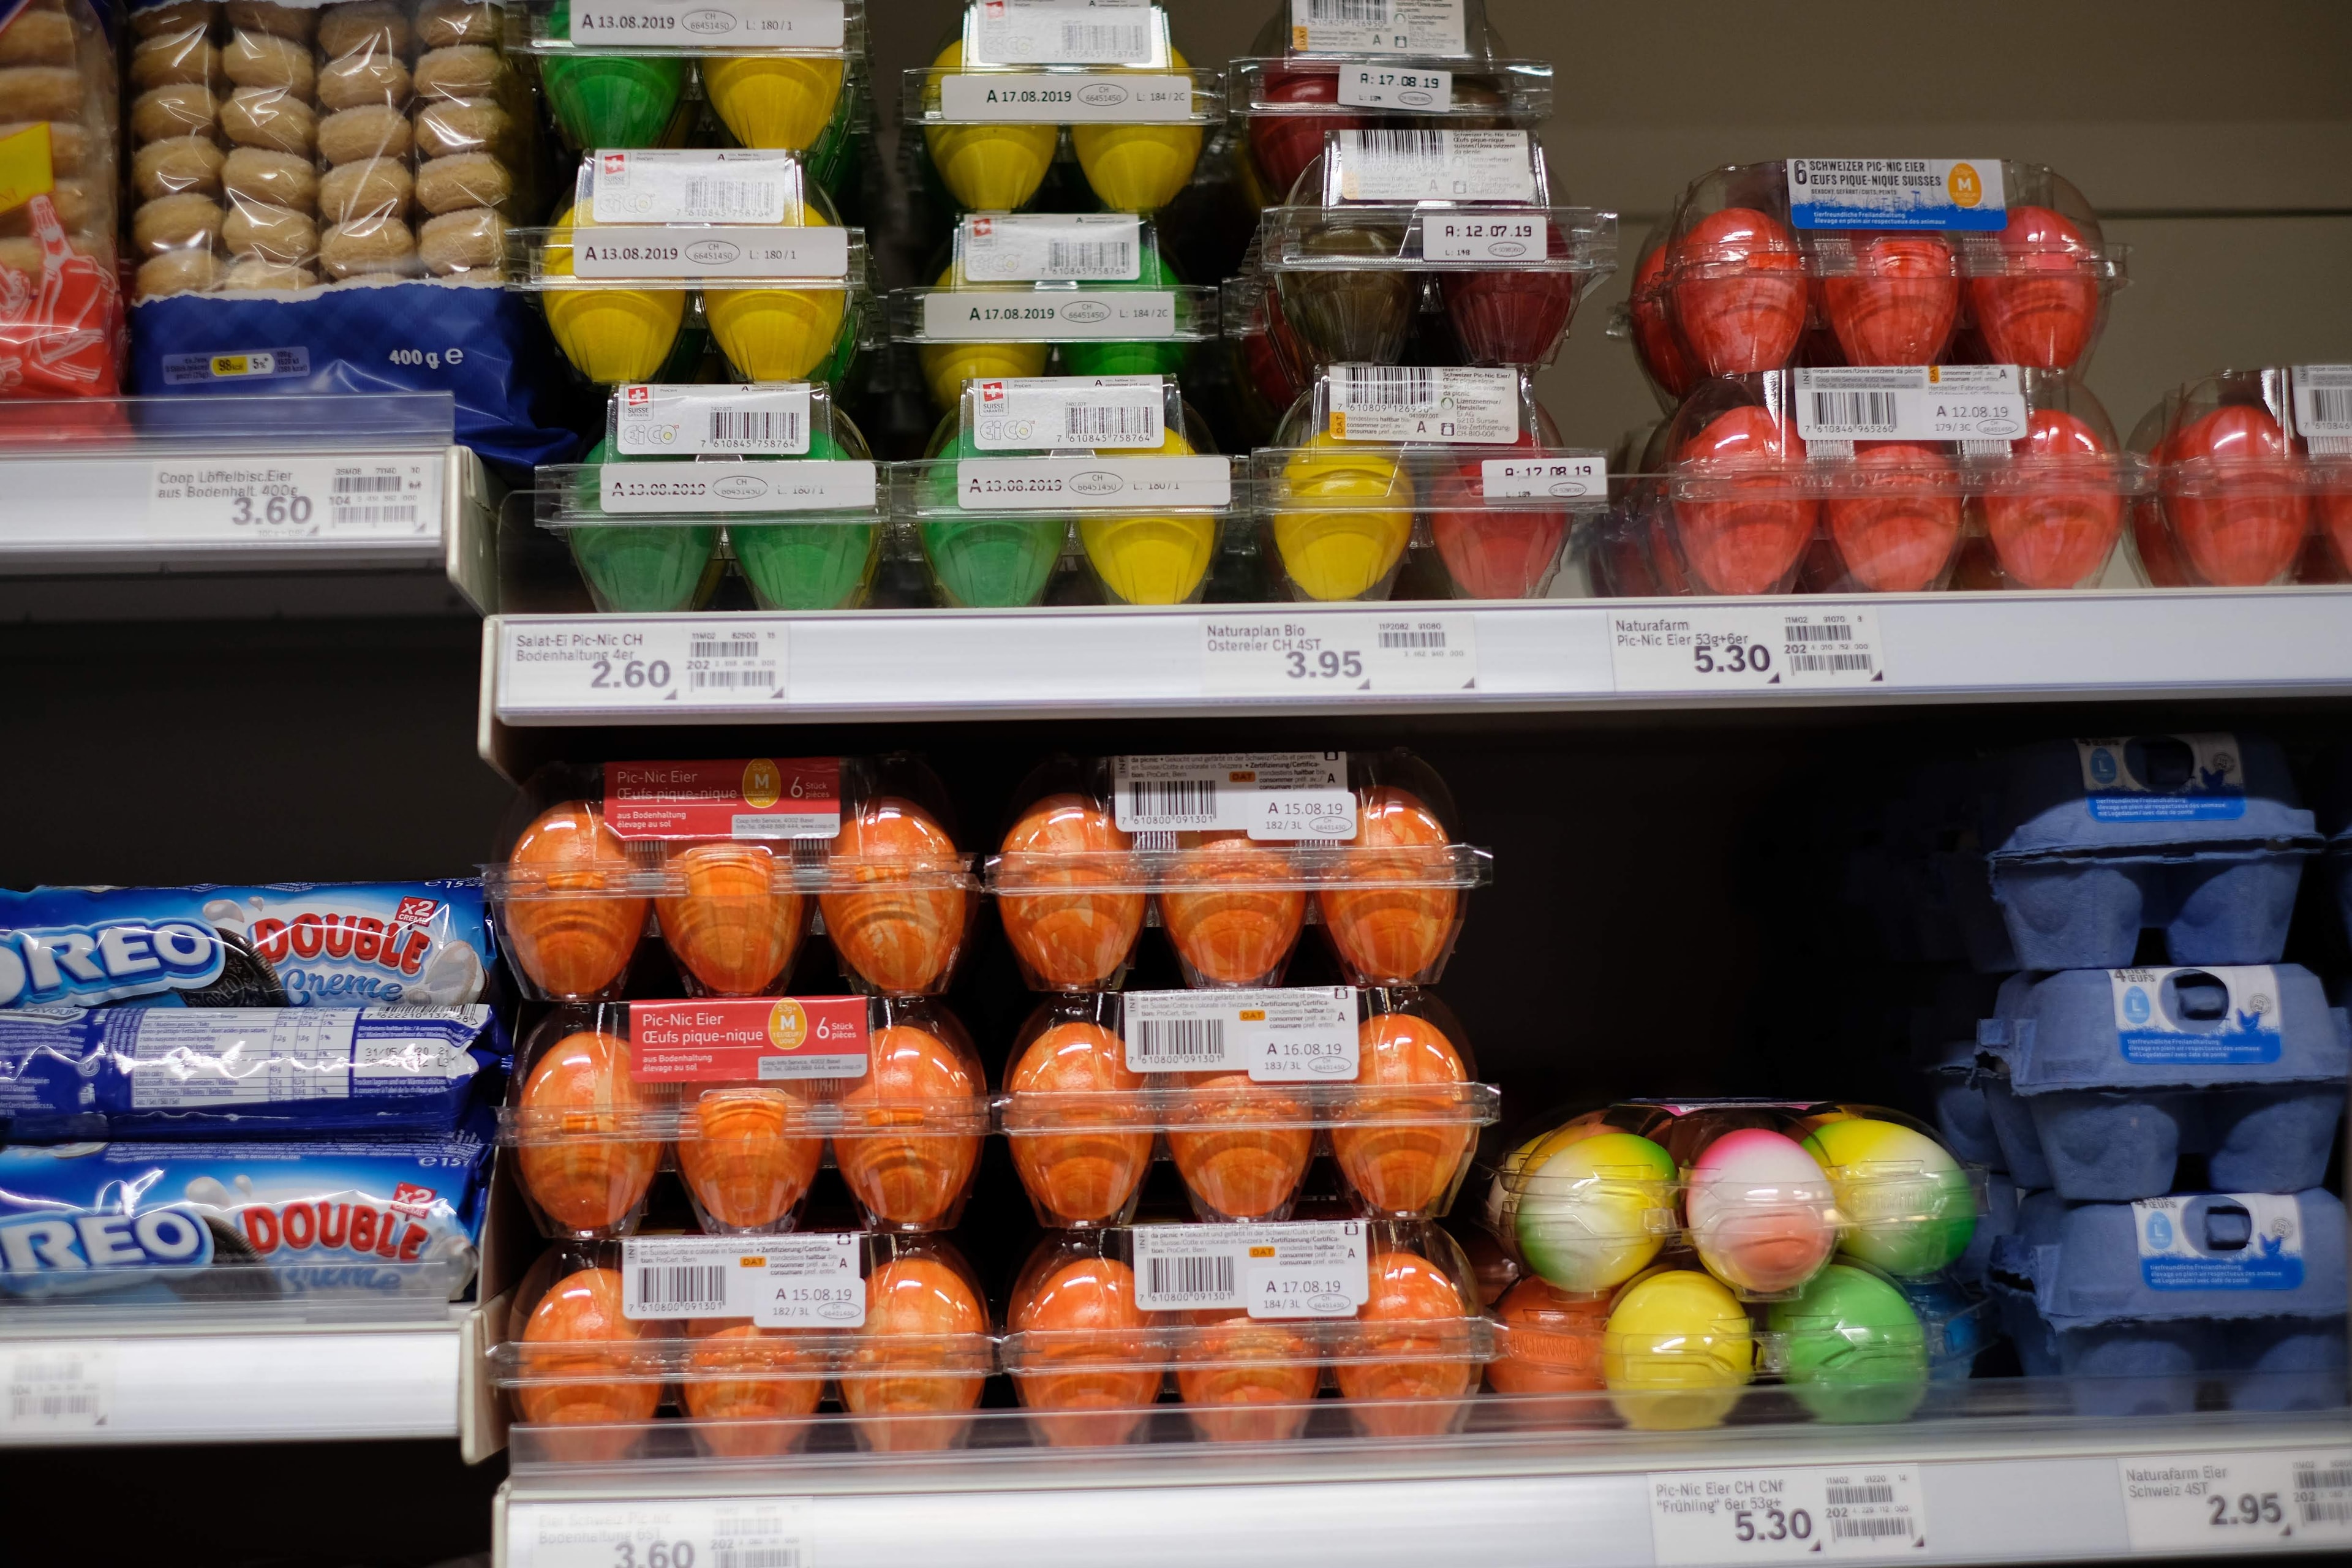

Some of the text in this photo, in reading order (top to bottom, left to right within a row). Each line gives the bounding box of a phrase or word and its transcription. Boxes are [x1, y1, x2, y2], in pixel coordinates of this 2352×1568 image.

[582, 14, 675, 29] A 13.08.2019
[690, 21, 731, 30] 66451450
[1379, 74, 1439, 89] 17.08.19
[986, 89, 1072, 103] A 17.08.2019
[1793, 159, 1807, 185] 6
[1809, 160, 1925, 173] SCHWEIZER PIC-NIC EIER
[1811, 175, 1941, 187] ŒUFS PIQUE-NIQUE SUISSES
[1957, 177, 1972, 192] M
[1465, 225, 1532, 237] 12.07.19
[585, 246, 678, 260] A 13.08.2019
[970, 307, 1055, 321] A 17.08.2019
[389, 349, 423, 366] 400
[1936, 405, 2008, 418] A 12.08.19
[1417, 421, 1427, 433] A
[159, 471, 194, 486] Coop
[970, 478, 982, 492] A
[159, 486, 298, 499] aus Bodenhalt. 400g
[612, 481, 625, 496] A
[329, 496, 352, 506] 104
[232, 496, 313, 526] 3.60
[1207, 624, 1305, 639] Naturaplan Bio
[1616, 620, 1689, 632] Naturafarm
[516, 633, 643, 647] Salat-Ei Pic-Nic CH
[1207, 639, 1322, 651] Ostereier CH 4ST
[1618, 633, 1748, 647] Pic-Nic Eier 53g+6er
[516, 649, 608, 662] Bodenhaltung
[1784, 645, 1807, 654] 202
[1286, 650, 1362, 679] 3.95
[1694, 644, 1770, 673] 5.30
[591, 660, 671, 688] 2.60
[1250, 761, 1320, 769] Zertifizierung/Certifica-
[617, 771, 698, 784] Pic-Nic Eier
[755, 774, 769, 789] M
[1232, 773, 1253, 782] DAT
[790, 776, 803, 798] 6
[617, 788, 737, 803] Œufs pique-nique
[805, 790, 830, 799] pièces
[633, 810, 687, 820] Bodenhaltung
[1268, 802, 1343, 815] A 15.08.19
[617, 820, 647, 829] élevage
[1134, 815, 1214, 824] 610800 091301
[401, 900, 434, 917] x2
[254, 913, 431, 975] DOUBLE
[2127, 974, 2155, 982] ŒUFS
[282, 967, 405, 1006] Creme
[643, 1013, 725, 1027] Pic-Nic Eier
[780, 1015, 796, 1030] M
[832, 1022, 854, 1031] Stück
[816, 1017, 829, 1039] 6
[643, 1029, 763, 1046] Œufs pique-nique
[832, 1031, 857, 1041] pièces
[1267, 1043, 1342, 1055] A 16.08.19
[658, 1054, 712, 1065] Bodenhaltung
[1142, 1055, 1221, 1064] 610800 091301
[643, 1063, 673, 1073] élevage
[685, 1063, 698, 1071] sol
[243, 1202, 428, 1261] DOUBLE
[743, 1257, 764, 1266] DAT
[1266, 1280, 1341, 1293] A 17.08.19
[775, 1288, 852, 1301] A 15.08.19
[1152, 1292, 1232, 1302] 610800 091301
[641, 1302, 723, 1311] 610800 091301
[2126, 1465, 2228, 1482] Naturafarm Eier
[1656, 1479, 1785, 1497] Pic-Nic Eier CH CNf
[2128, 1482, 2208, 1498] Schweiz 4ST
[1656, 1496, 1781, 1515] "Frühling" 6er 53g+
[1825, 1507, 1848, 1518] 202
[2206, 1491, 2282, 1526] 2.95
[1735, 1508, 1812, 1542] 5.30
[538, 1530, 632, 1545] Bodenhaltung
[614, 1539, 695, 1568] 3.60
